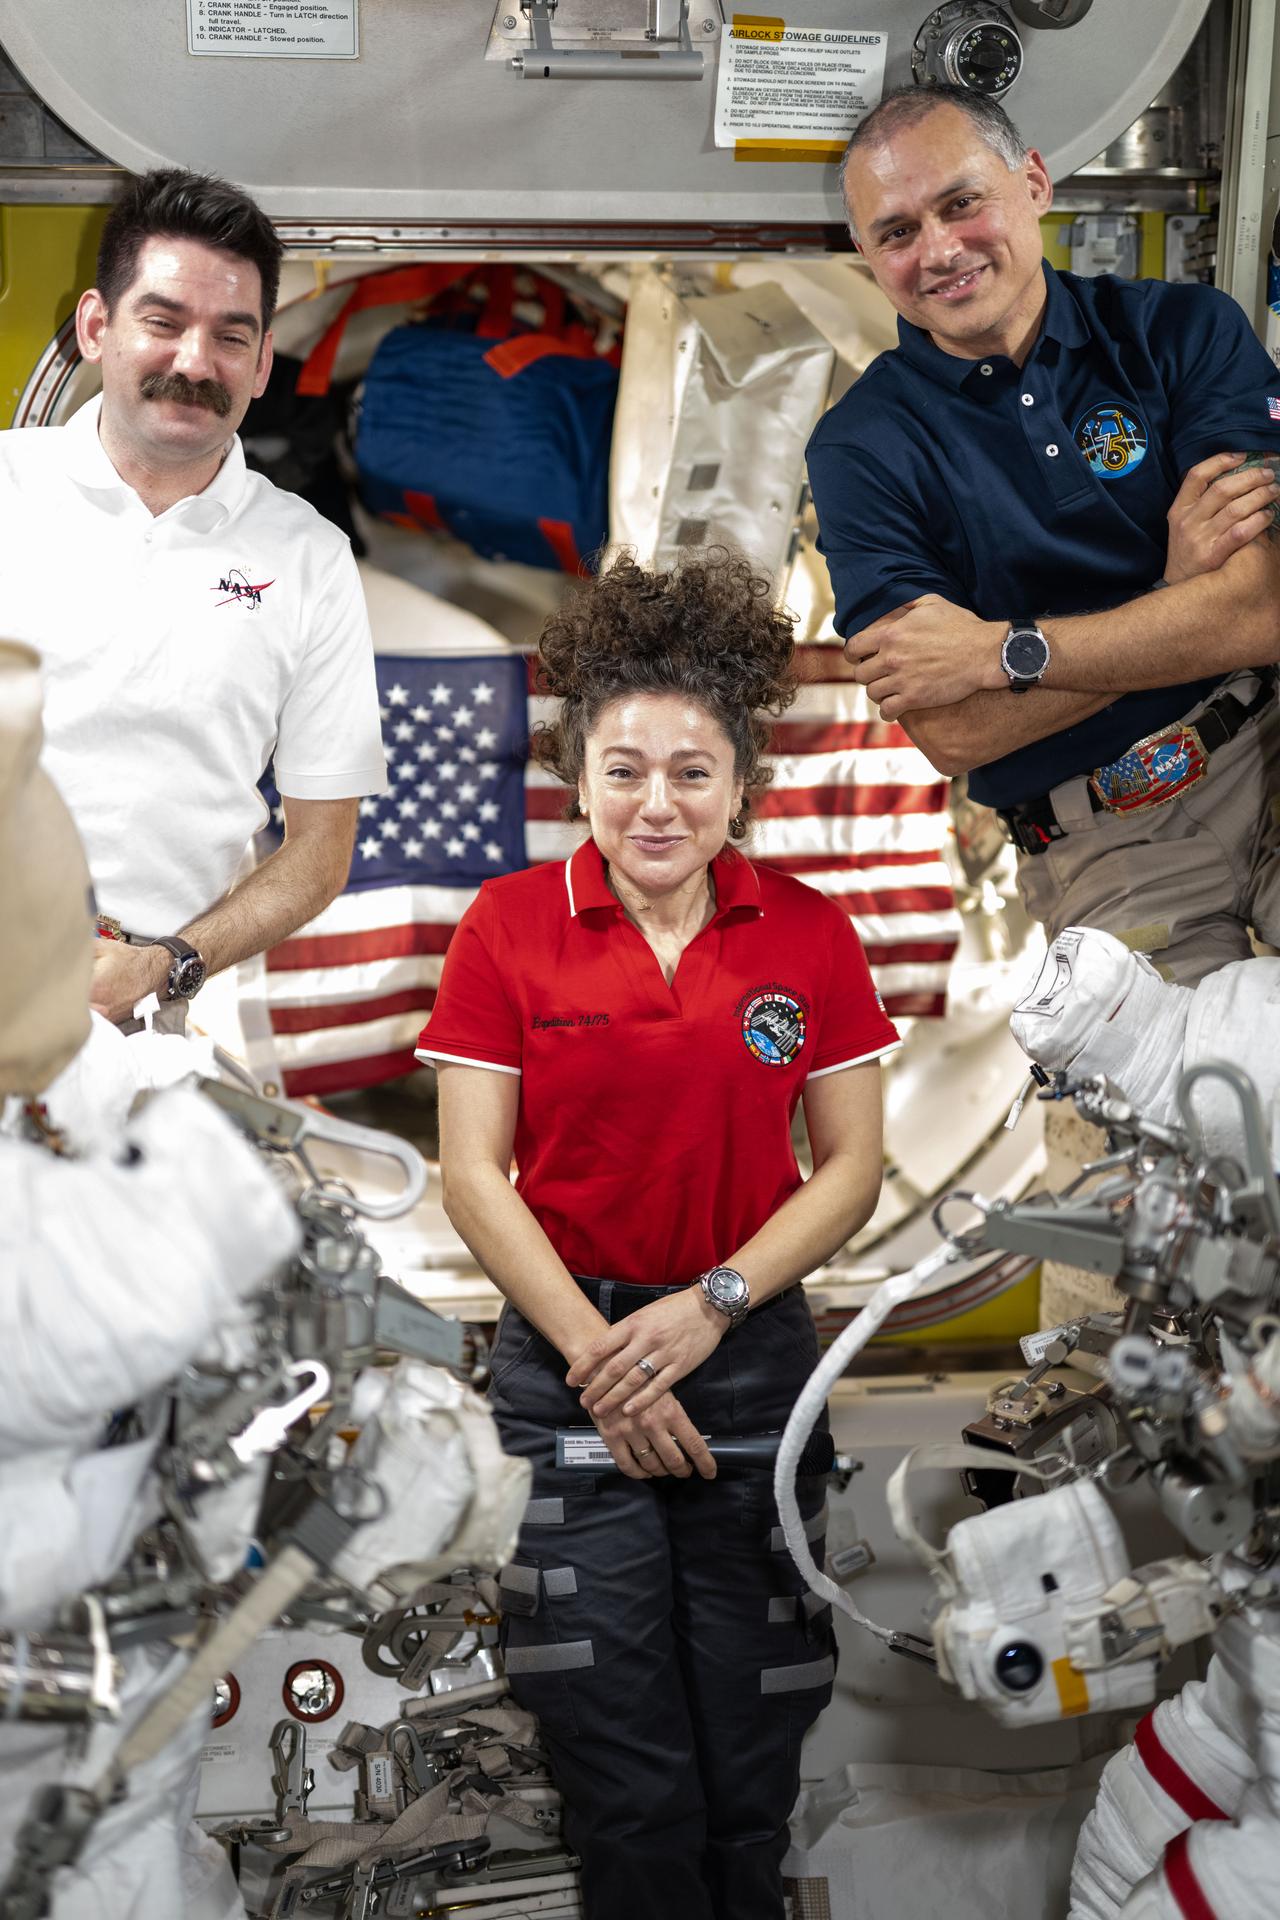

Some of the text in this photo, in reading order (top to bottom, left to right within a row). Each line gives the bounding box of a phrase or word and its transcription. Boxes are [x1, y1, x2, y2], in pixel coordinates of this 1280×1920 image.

[728, 30, 881, 44] AIRLOCK STOWAGE GUIDELINES
[1094, 432, 1128, 470] 75
[218, 578, 262, 602] NASA
[1155, 753, 1187, 774] NASA
[772, 982, 797, 997] Space
[577, 1014, 609, 1027] 74/75
